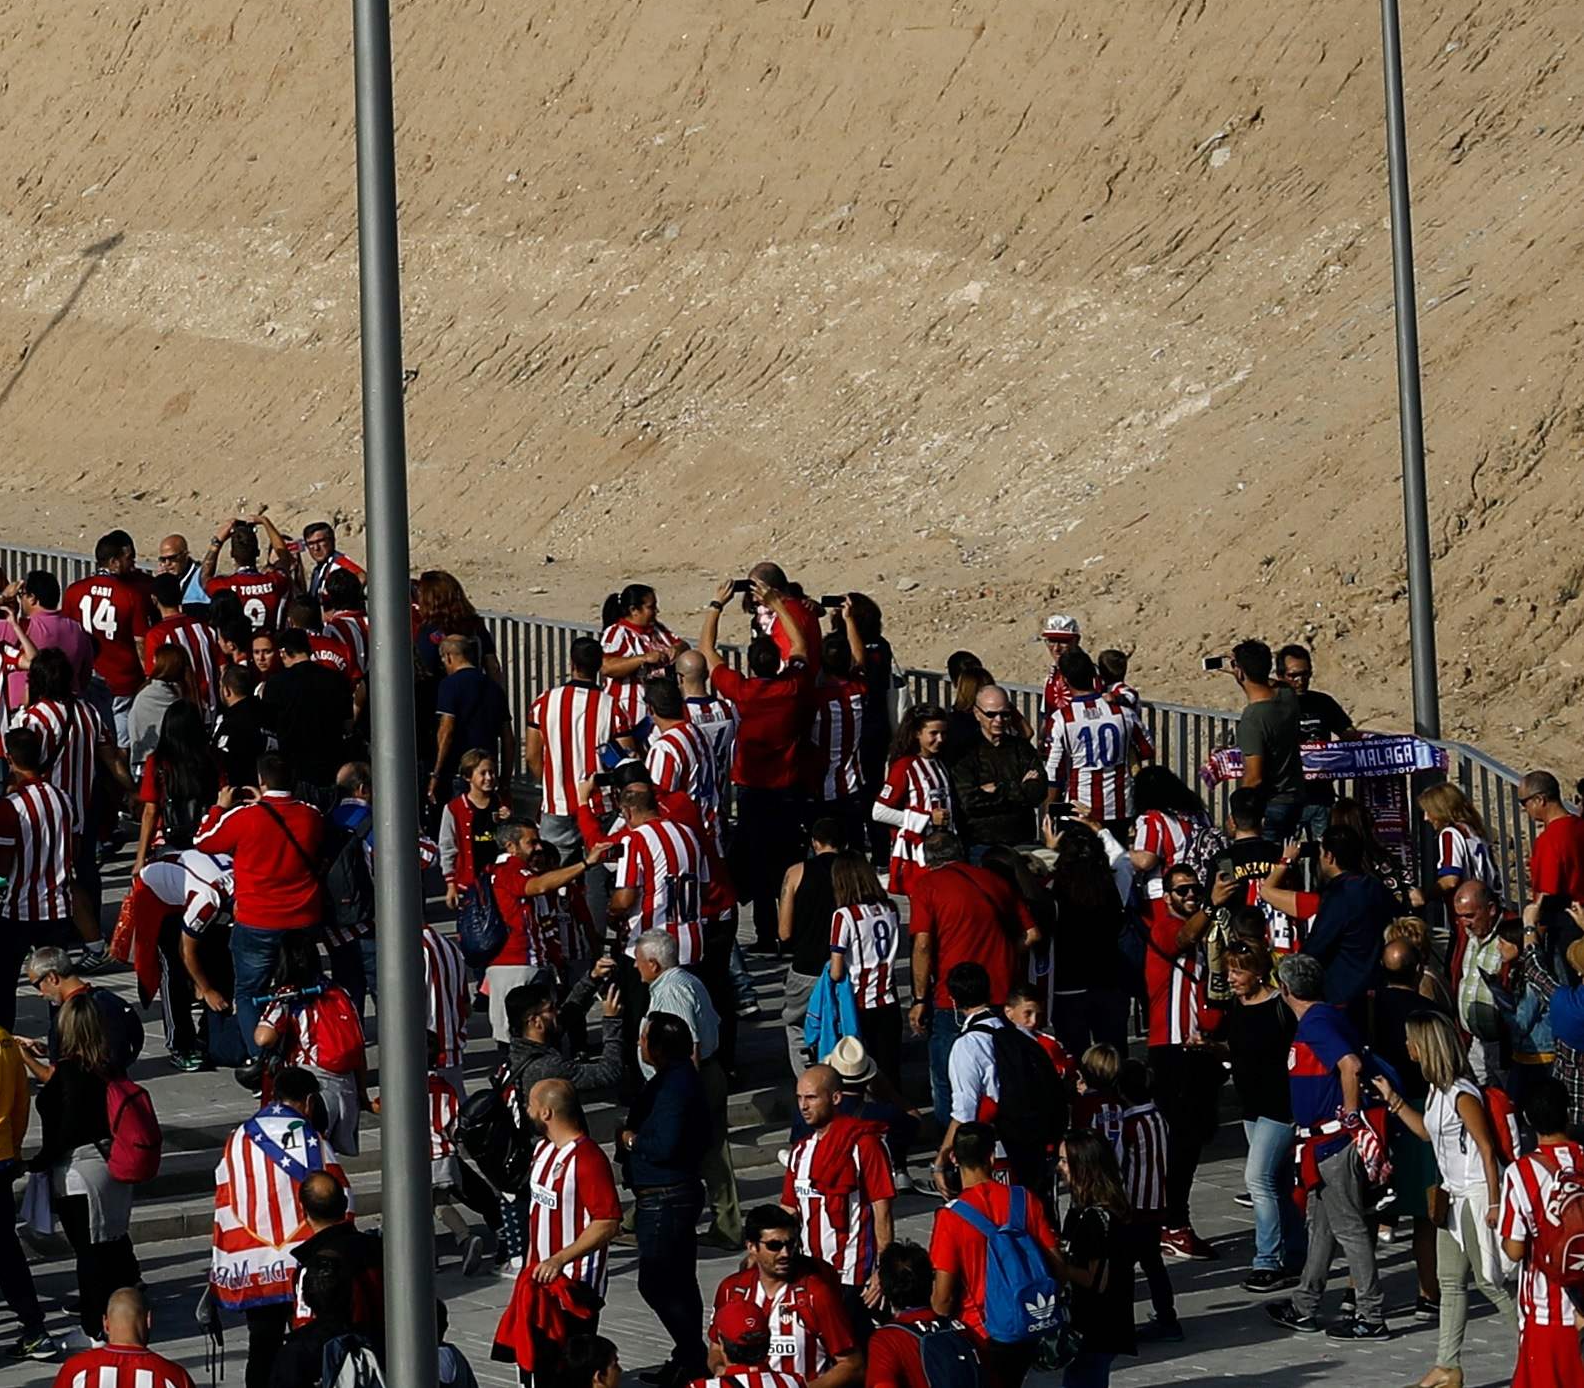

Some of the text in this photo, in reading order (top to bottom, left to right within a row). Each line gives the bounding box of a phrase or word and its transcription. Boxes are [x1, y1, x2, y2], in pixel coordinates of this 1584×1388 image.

[91, 585, 112, 597] GABI
[240, 582, 273, 596] TORRES
[79, 594, 118, 640] 14
[1078, 722, 1119, 768] 10
[1327, 740, 1362, 750] PARTIDO
[1365, 736, 1413, 747] INAUGURAL
[1355, 745, 1415, 769] MALAGA
[665, 873, 698, 922] 10
[873, 920, 890, 960] 8
[1027, 1318, 1059, 1334] adidas
